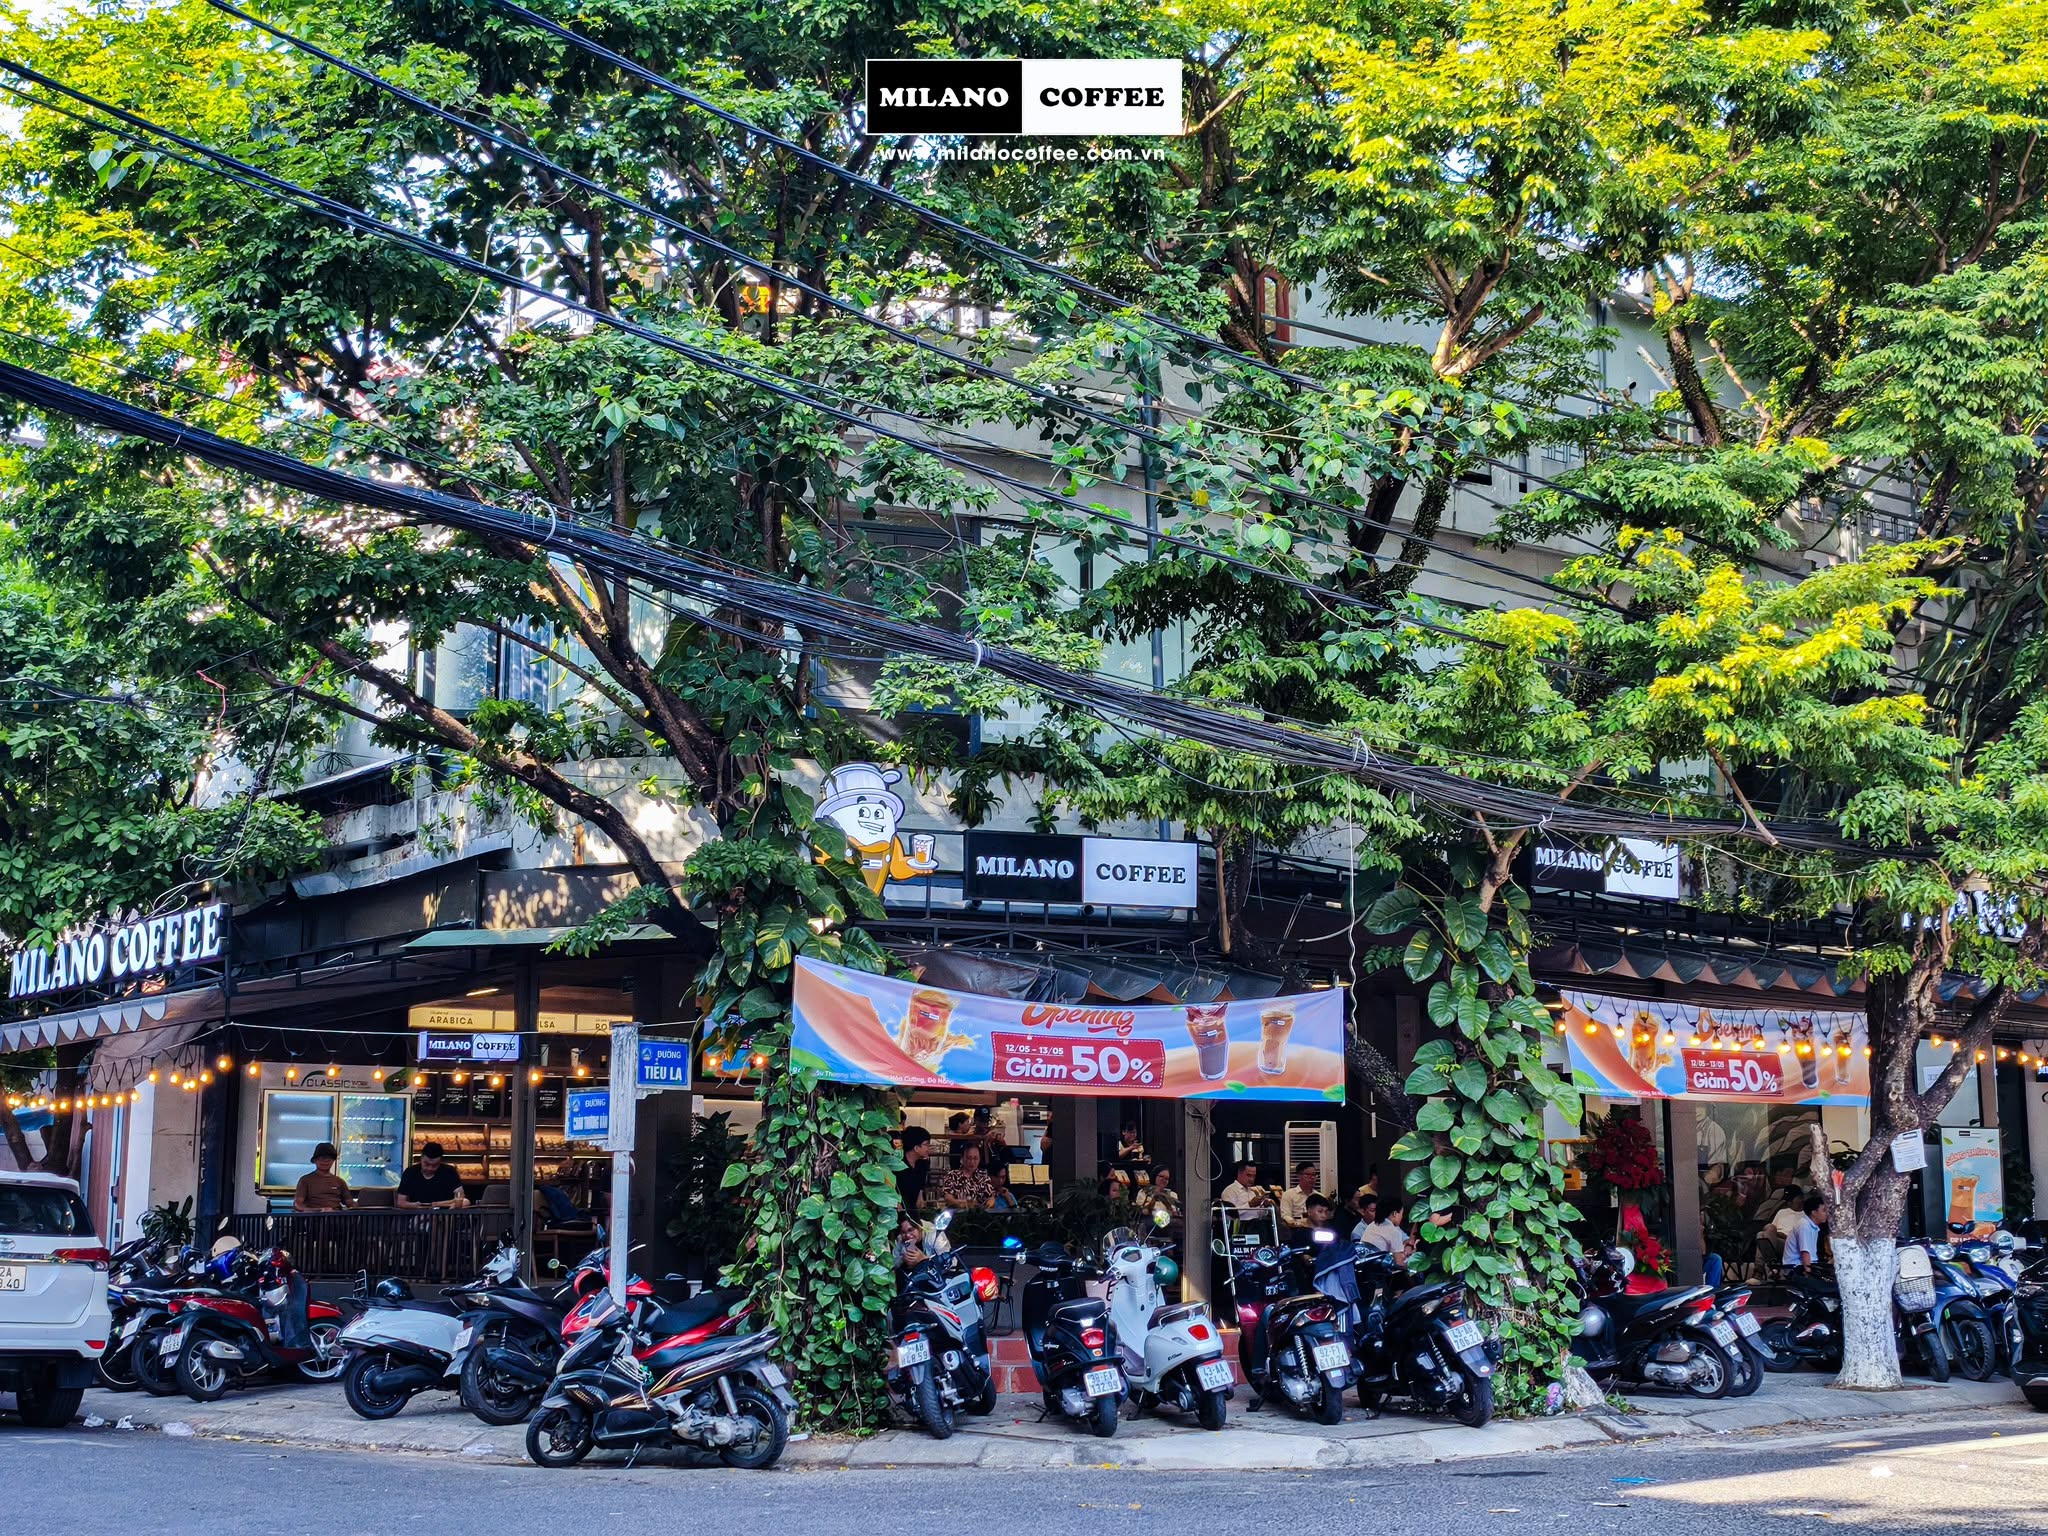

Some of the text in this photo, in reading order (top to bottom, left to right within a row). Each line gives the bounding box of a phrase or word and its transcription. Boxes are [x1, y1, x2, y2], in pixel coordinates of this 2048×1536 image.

[975, 855, 1187, 884] MILANO COFFEE
[1535, 846, 1604, 872] MILANO
[8, 902, 222, 999] MILANO COFFEE
[429, 1015, 474, 1025] ARABICA
[1020, 1002, 1137, 1037] Opening
[428, 1039, 516, 1052] MILANO COFFEE
[1005, 1044, 1031, 1054] 12/05
[1038, 1045, 1065, 1055] 13/05
[669, 1066, 683, 1081] LA
[1005, 1045, 1154, 1084] Giảm 50%
[1693, 1058, 1778, 1092] Giảm 50%
